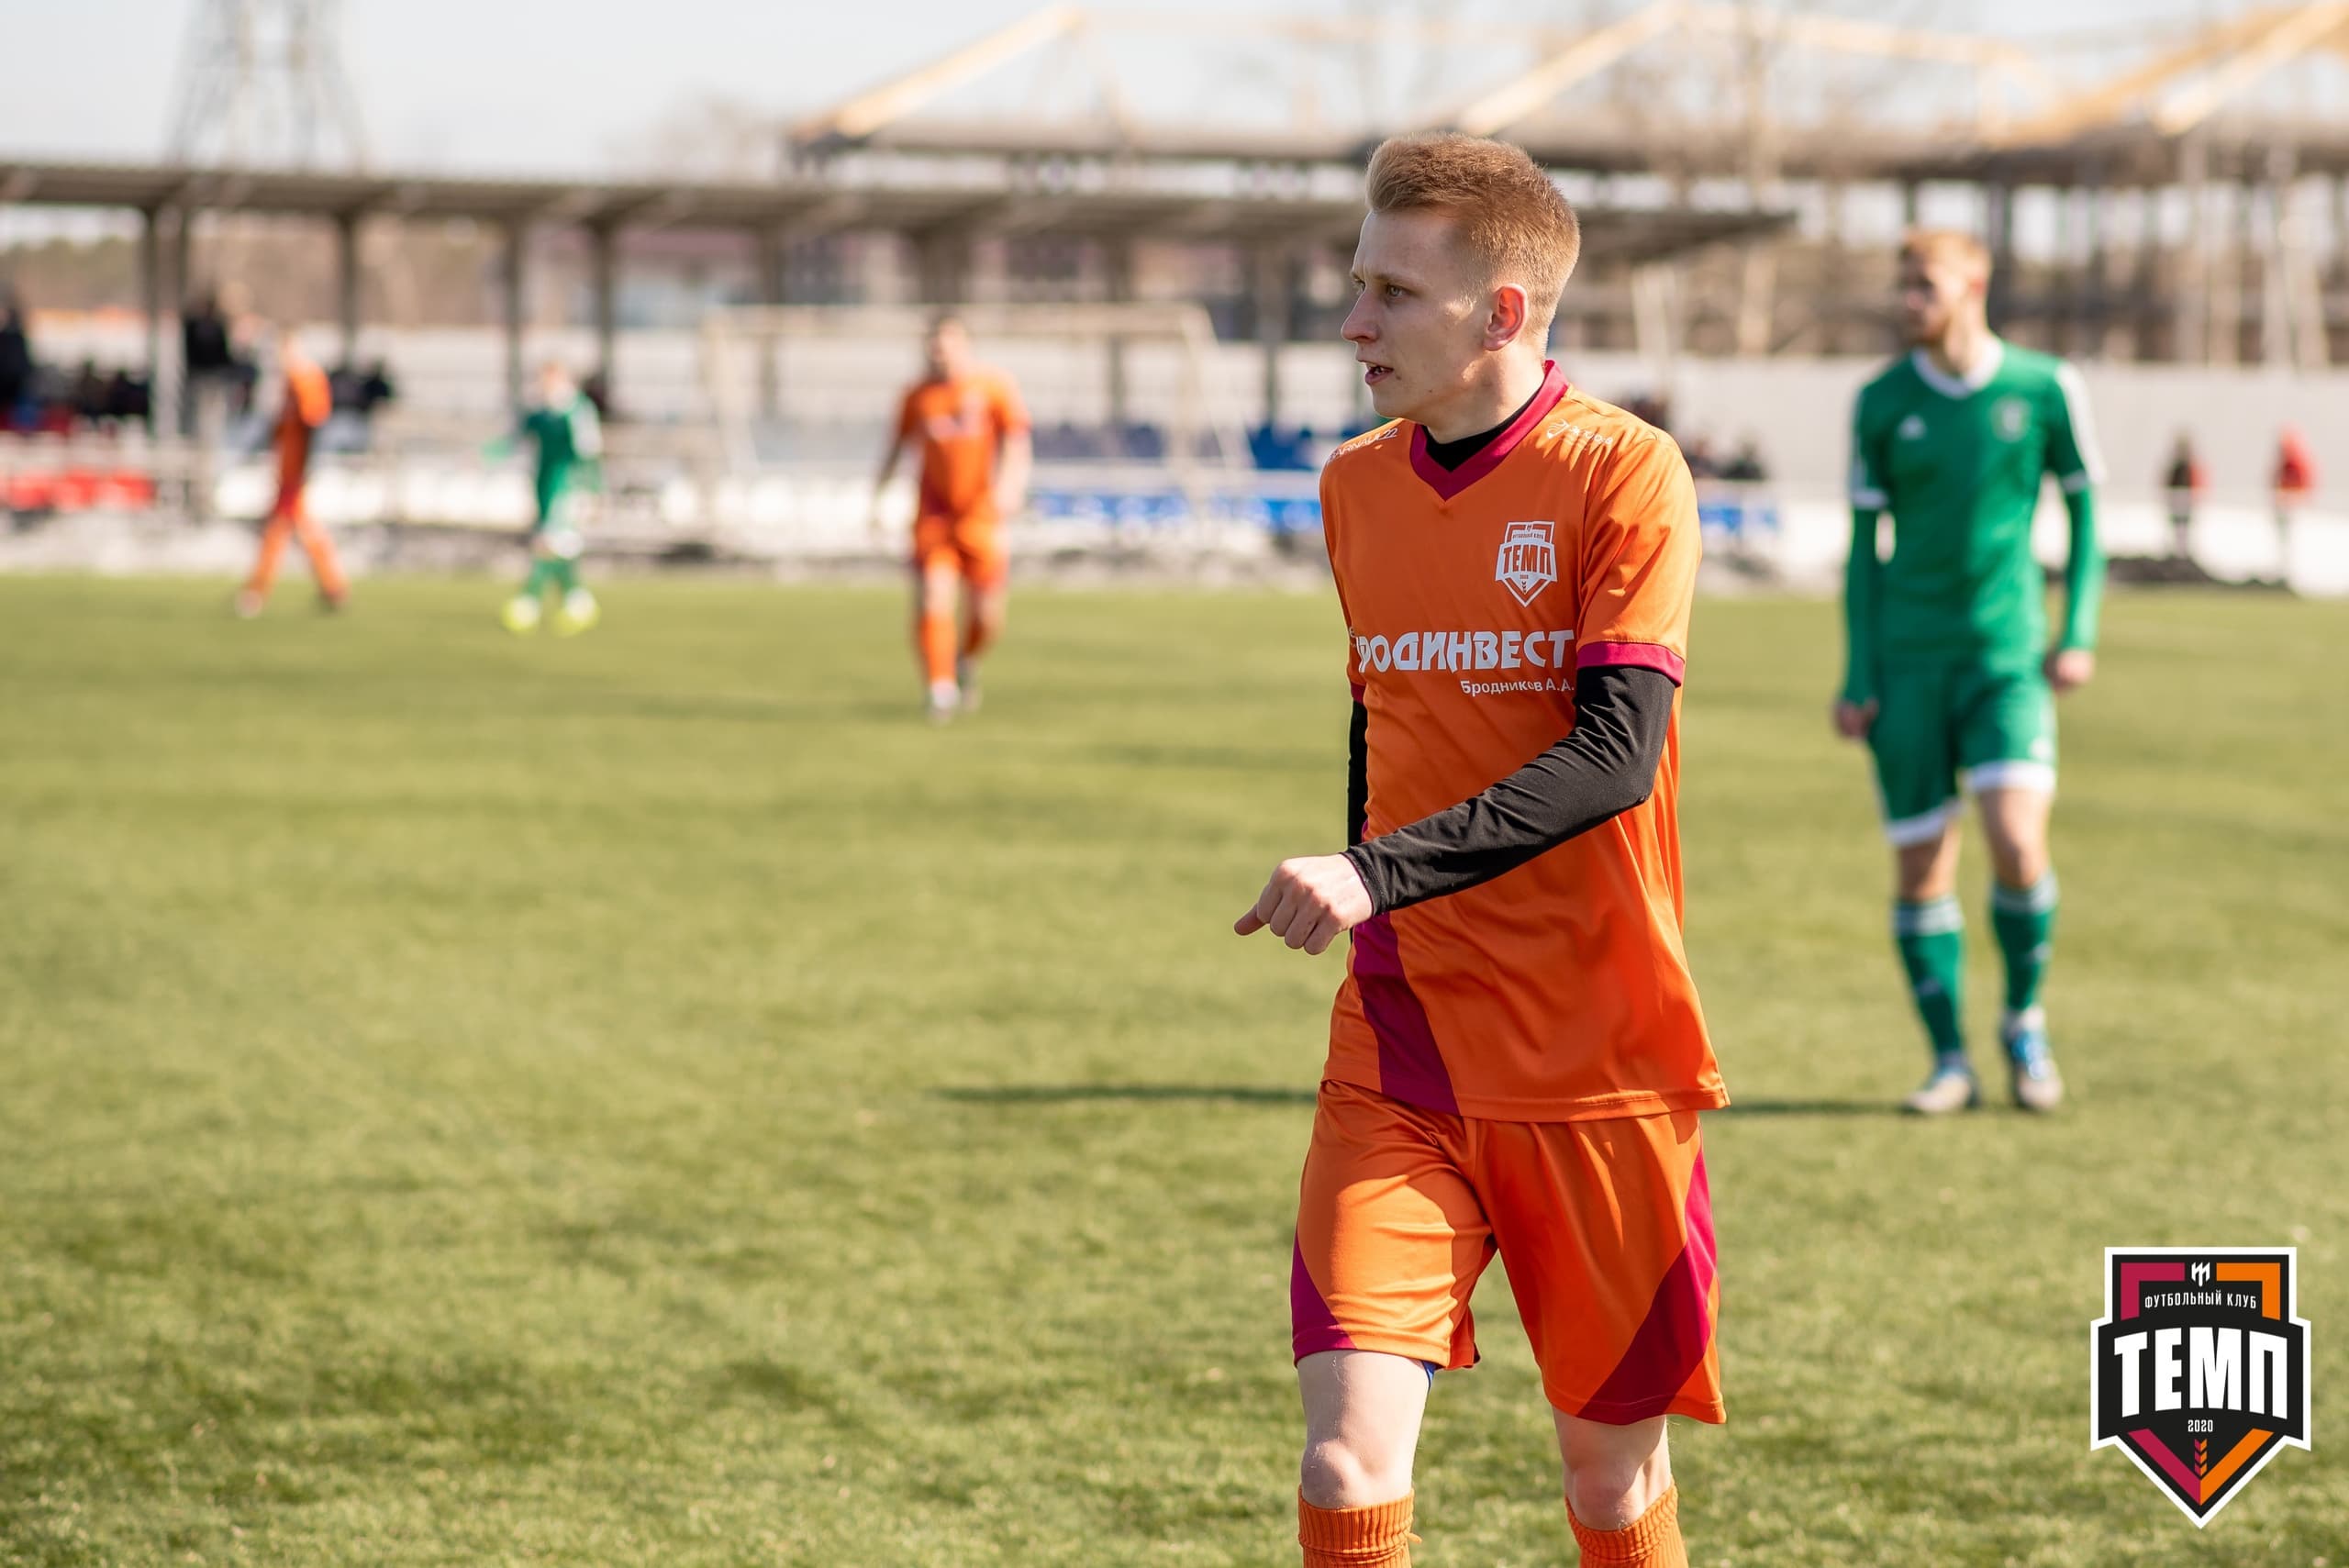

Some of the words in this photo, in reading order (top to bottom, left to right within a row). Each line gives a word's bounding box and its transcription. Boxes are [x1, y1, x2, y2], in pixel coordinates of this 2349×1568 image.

[1503, 544, 1552, 575] ТЕМП
[1356, 629, 1575, 673] РОДИНВЕСТ
[1460, 680, 1543, 697] Бродников
